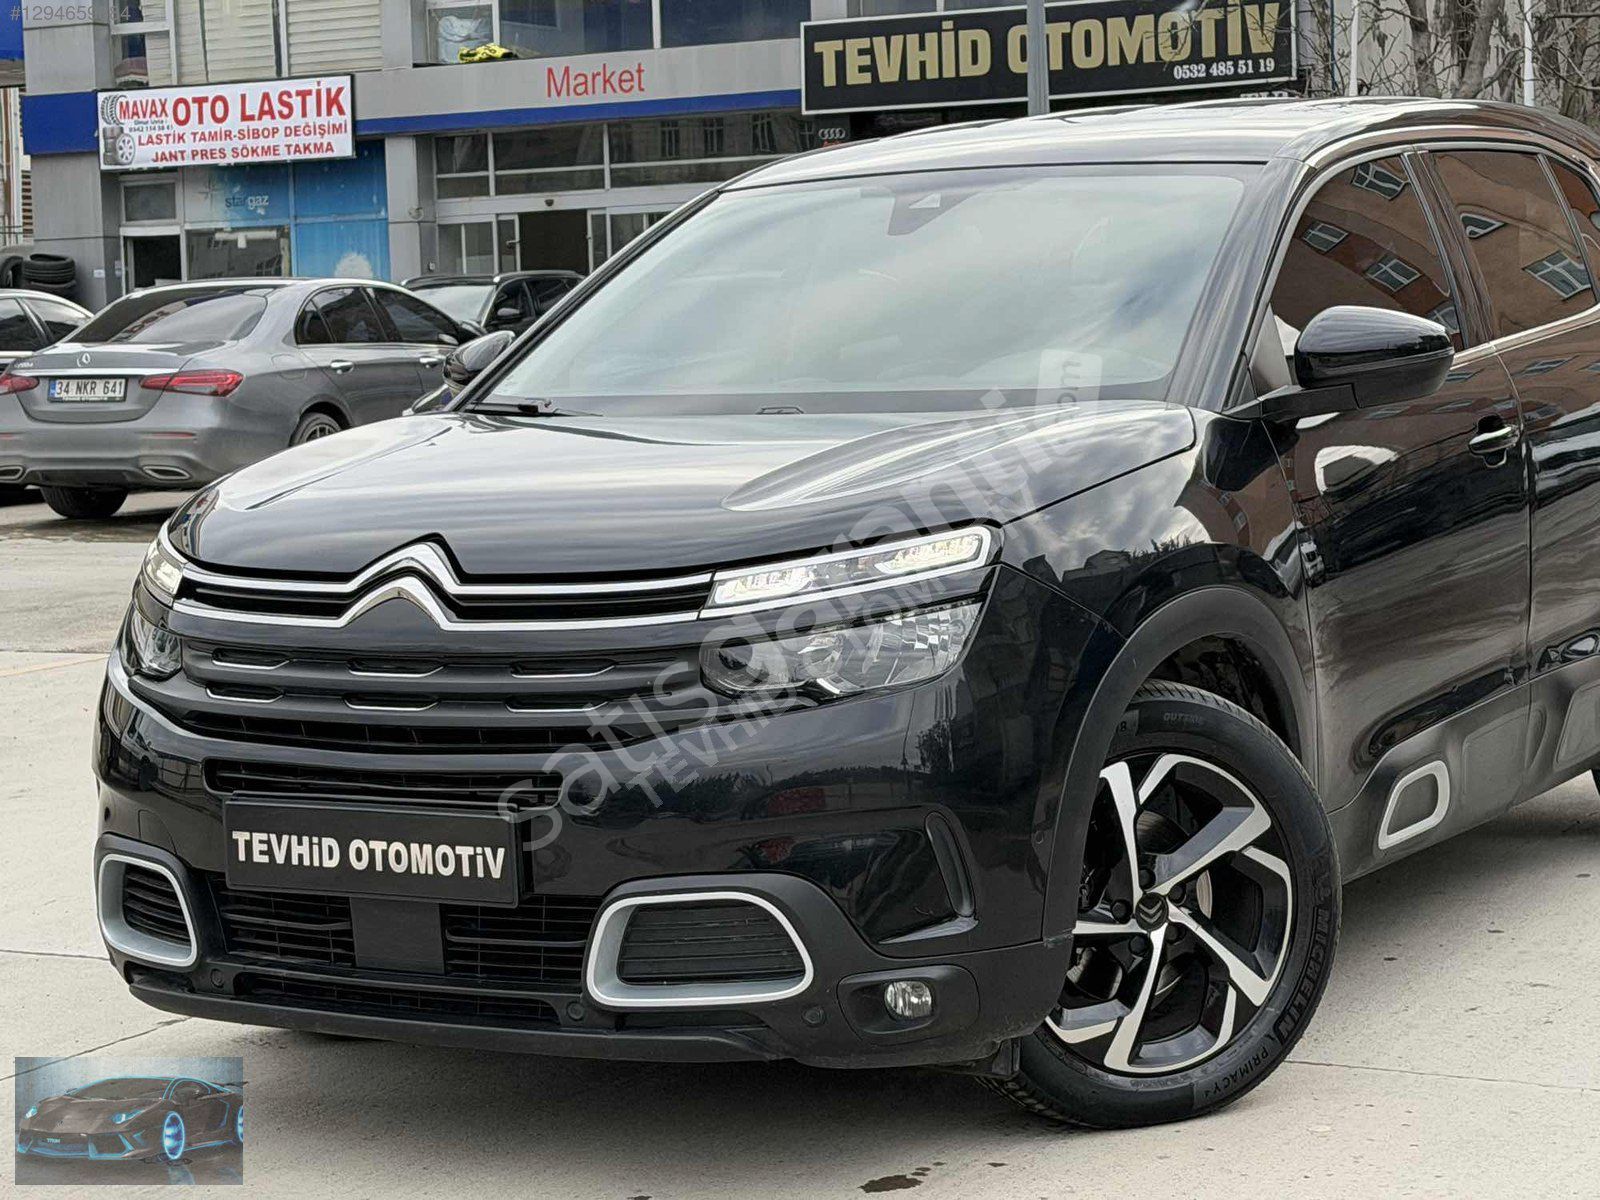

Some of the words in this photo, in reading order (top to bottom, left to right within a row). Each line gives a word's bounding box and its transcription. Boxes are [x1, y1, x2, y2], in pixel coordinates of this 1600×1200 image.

[814, 20, 991, 88] TEVHİD
[546, 62, 645, 98] Market
[1173, 63, 1206, 80] 0532
[1209, 61, 1234, 77] 485
[1237, 59, 1254, 74] 51
[1259, 58, 1275, 73] 19
[119, 98, 169, 120] MAVAX
[172, 94, 230, 127] OTO
[240, 81, 346, 123] LASTİK
[138, 129, 186, 146] LASTİK
[284, 119, 348, 139] DEĞİŞİMİ
[151, 150, 187, 163] JANT
[191, 148, 227, 161] PRES
[231, 144, 281, 159] SÖKME
[284, 141, 335, 156] TAKMA
[56, 381, 71, 396] 34
[75, 380, 97, 395] NKR
[103, 380, 123, 395] 641
[1213, 1046, 1269, 1094] PRIMACY
